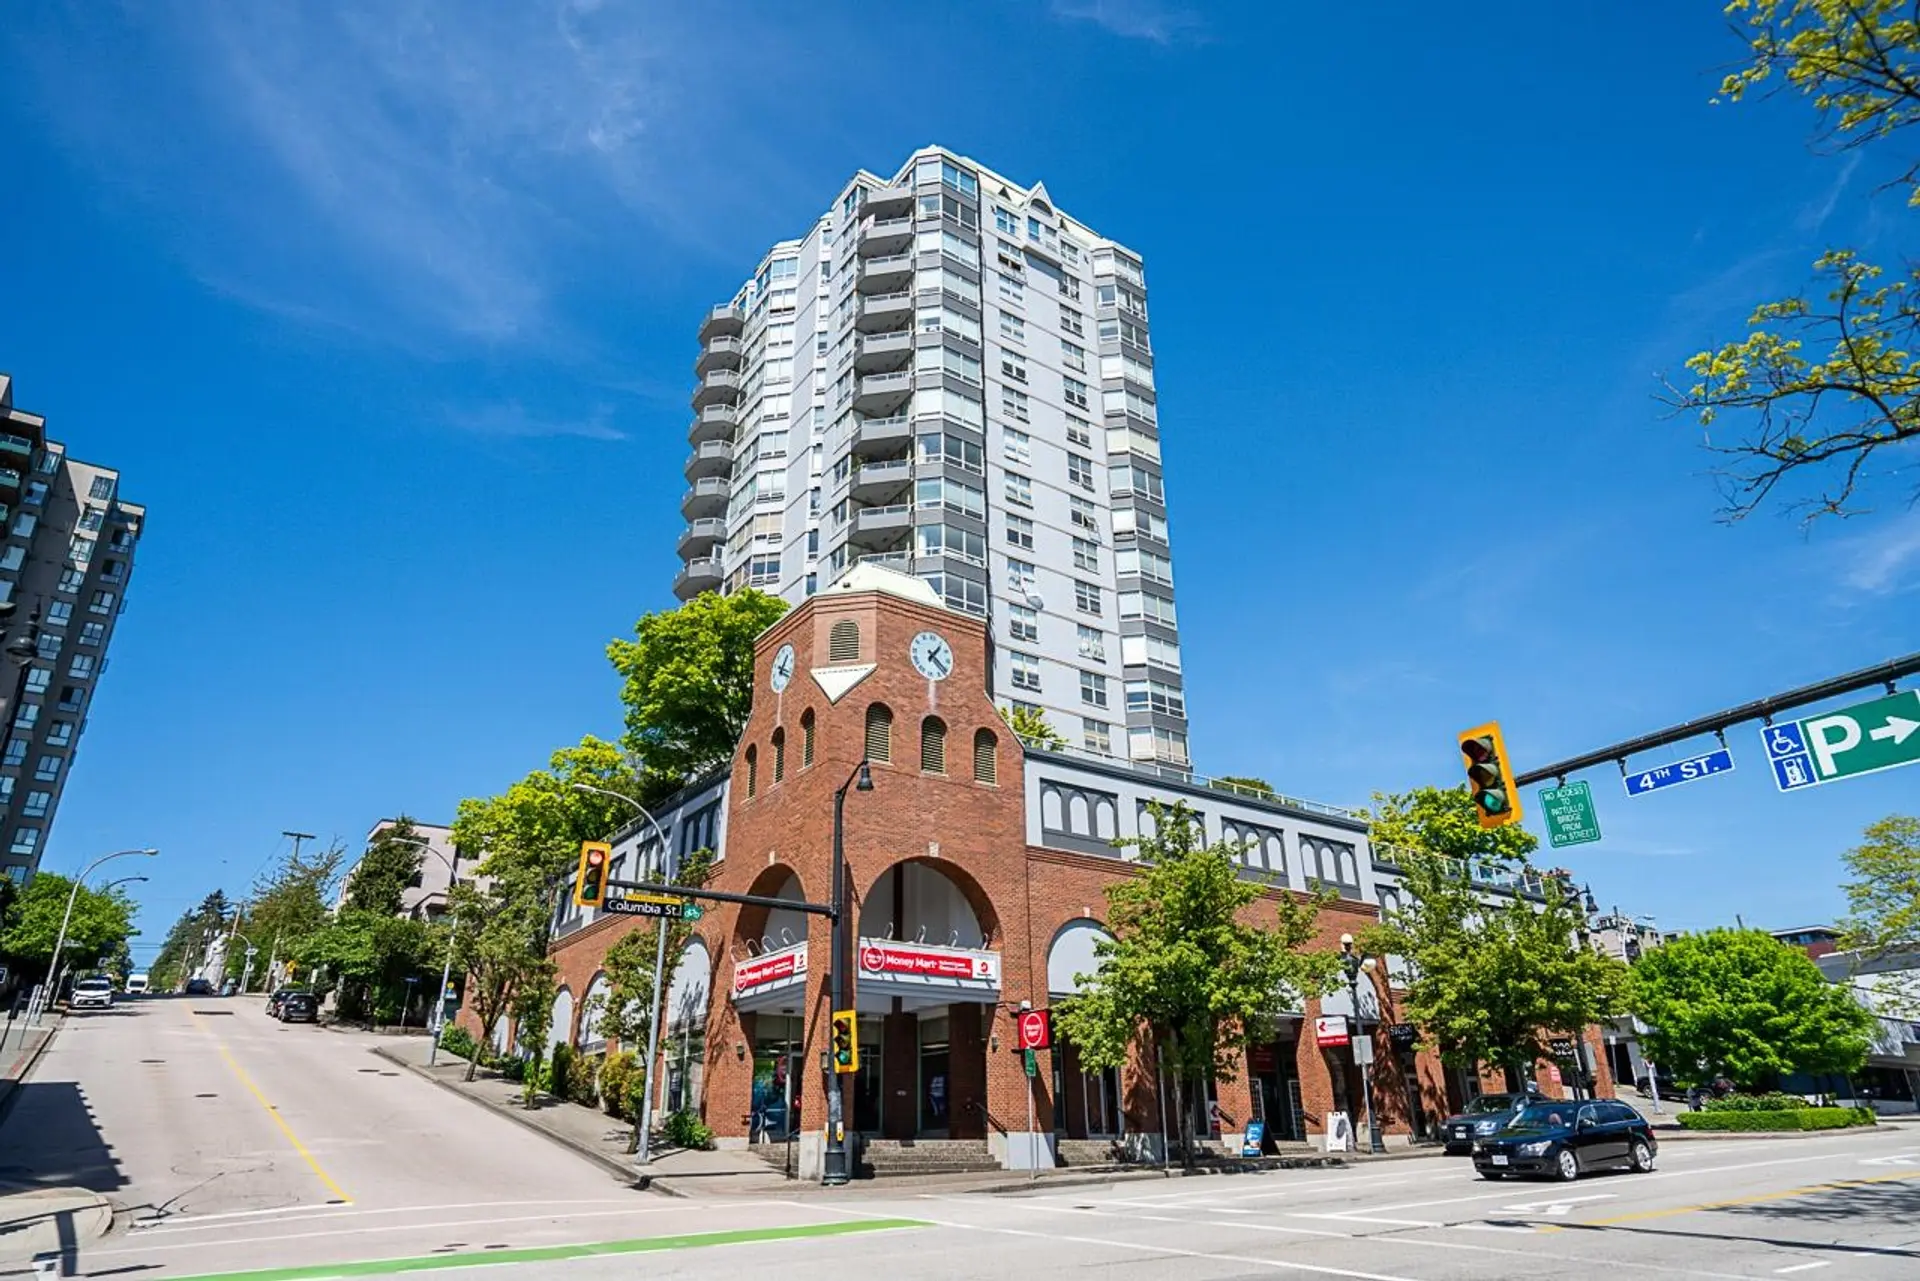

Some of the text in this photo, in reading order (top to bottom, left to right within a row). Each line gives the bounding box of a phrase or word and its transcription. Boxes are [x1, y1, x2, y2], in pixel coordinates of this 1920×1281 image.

[1805, 715, 1862, 777] P
[1639, 756, 1720, 789] 4TH ST.
[1544, 788, 1584, 801] NO ACCESS
[1560, 797, 1571, 805] TO
[607, 900, 661, 915] Columbia
[886, 954, 915, 969] Money
[915, 957, 935, 969] Mart
